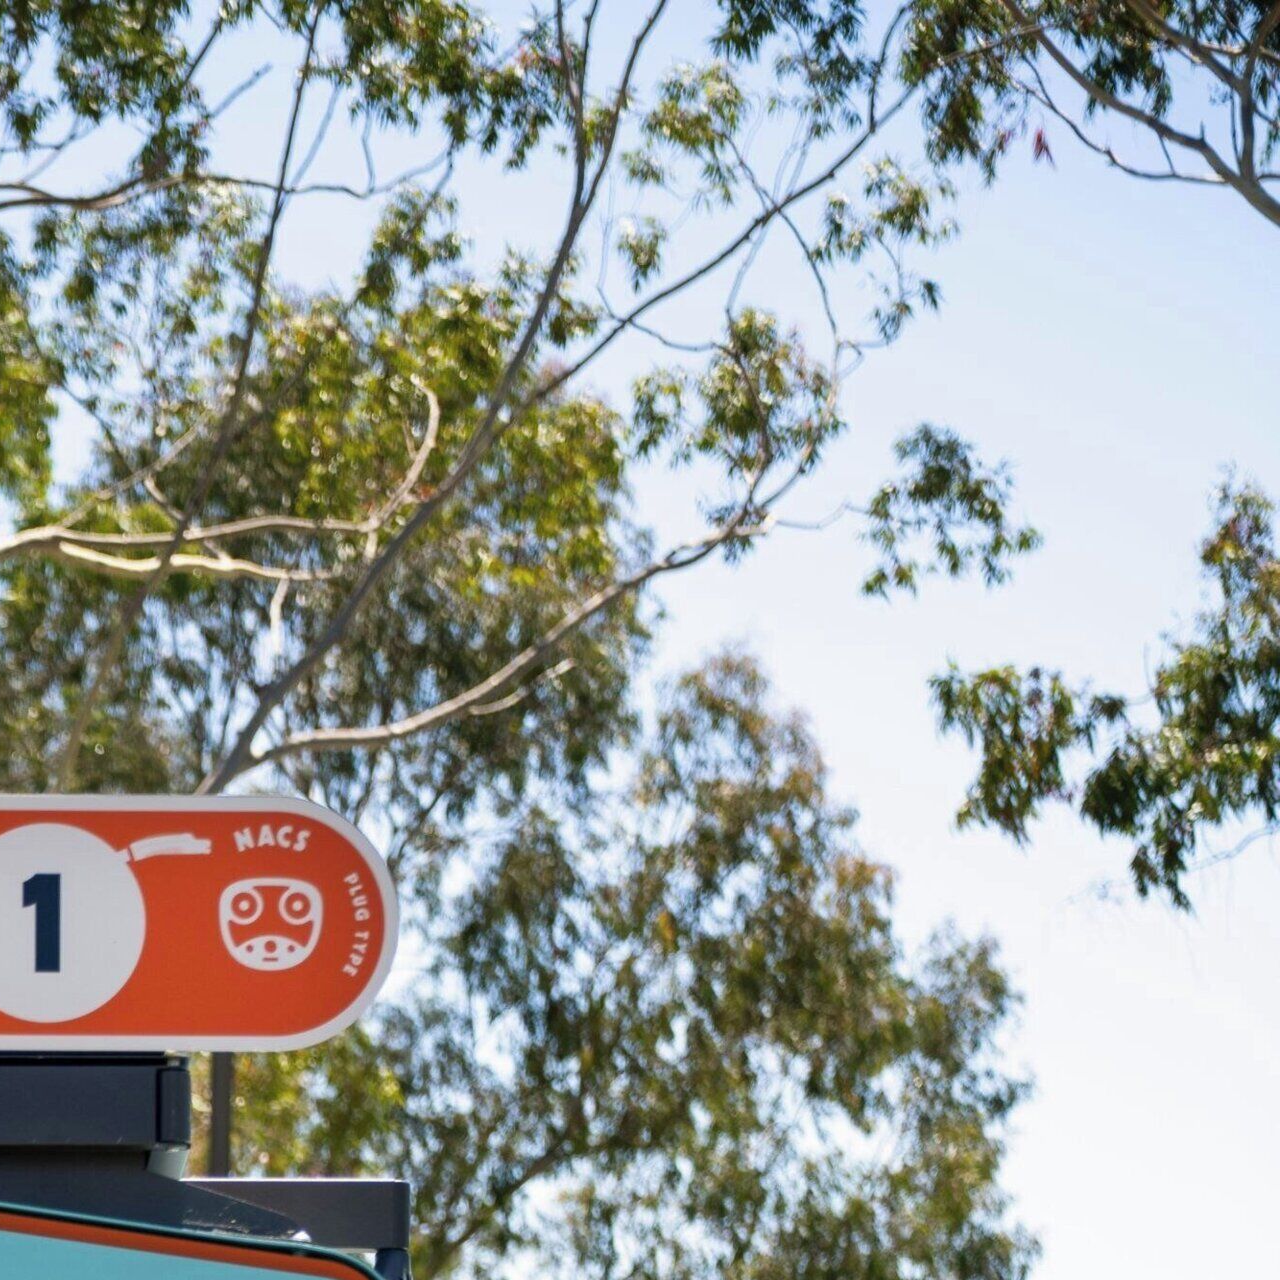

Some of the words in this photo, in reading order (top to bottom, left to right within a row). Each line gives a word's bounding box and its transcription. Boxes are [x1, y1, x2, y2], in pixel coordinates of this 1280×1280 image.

[233, 824, 311, 852] NACS
[344, 872, 371, 921] PLUG
[21, 872, 61, 972] 1
[342, 931, 369, 977] TYPE
